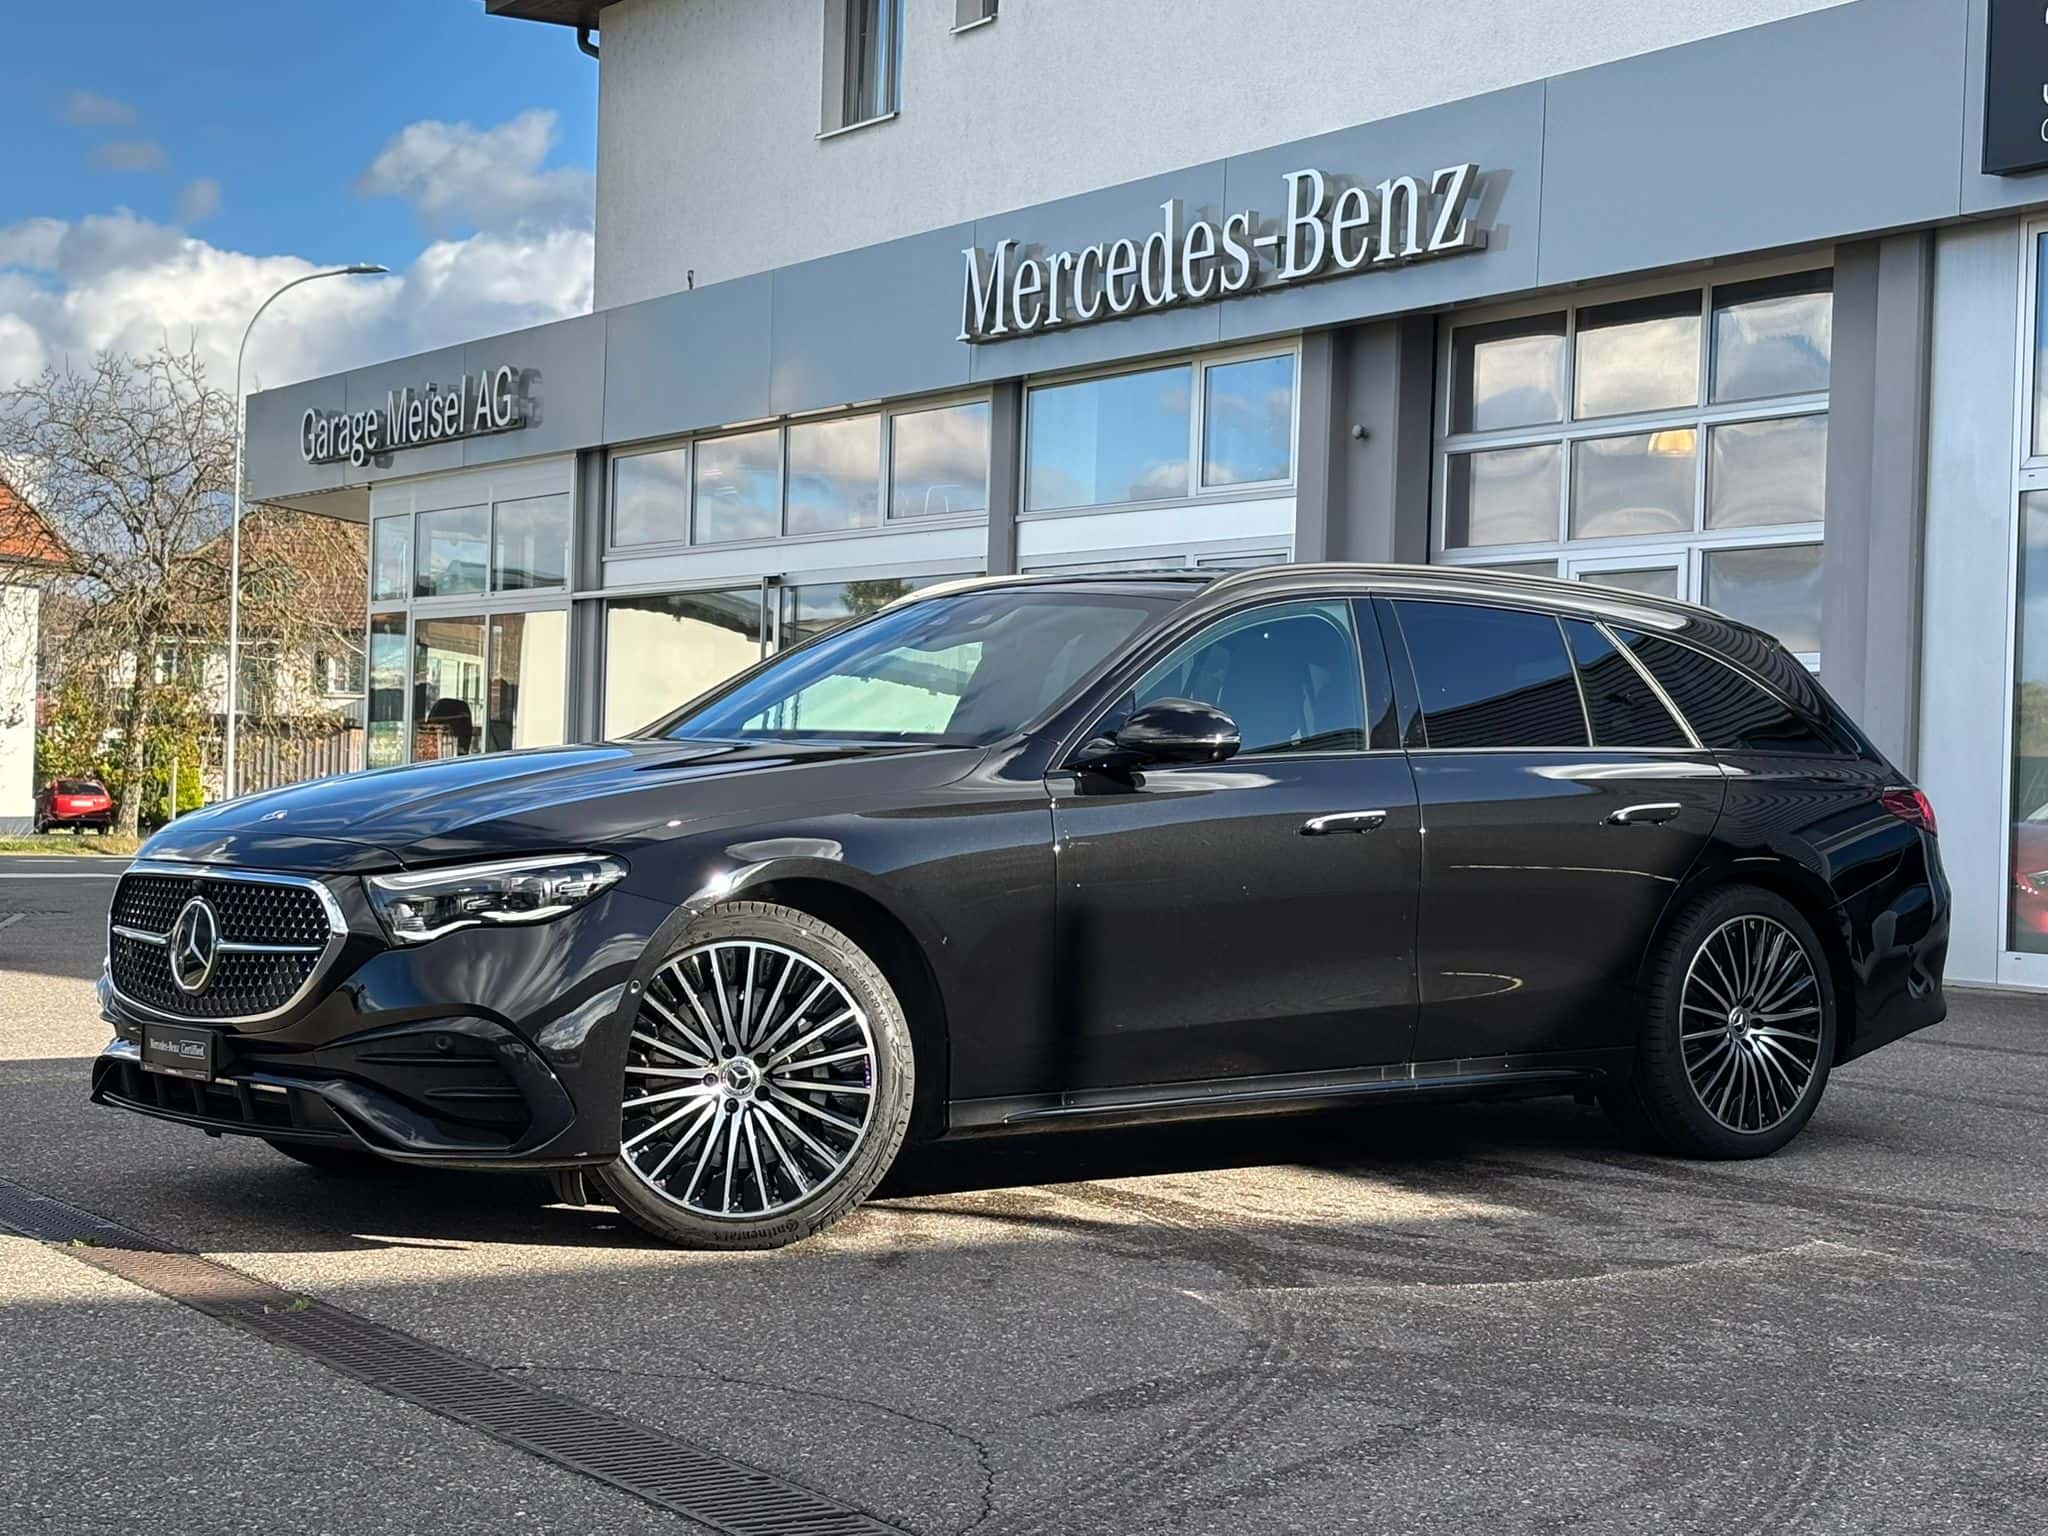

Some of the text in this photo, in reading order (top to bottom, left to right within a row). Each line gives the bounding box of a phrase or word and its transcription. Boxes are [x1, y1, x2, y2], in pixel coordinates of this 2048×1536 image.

[956, 163, 1479, 341] Mercedes-Benz
[301, 364, 513, 467] Garage Meisel AG
[181, 1042, 205, 1056] Certified
[724, 1219, 800, 1241] Continental
